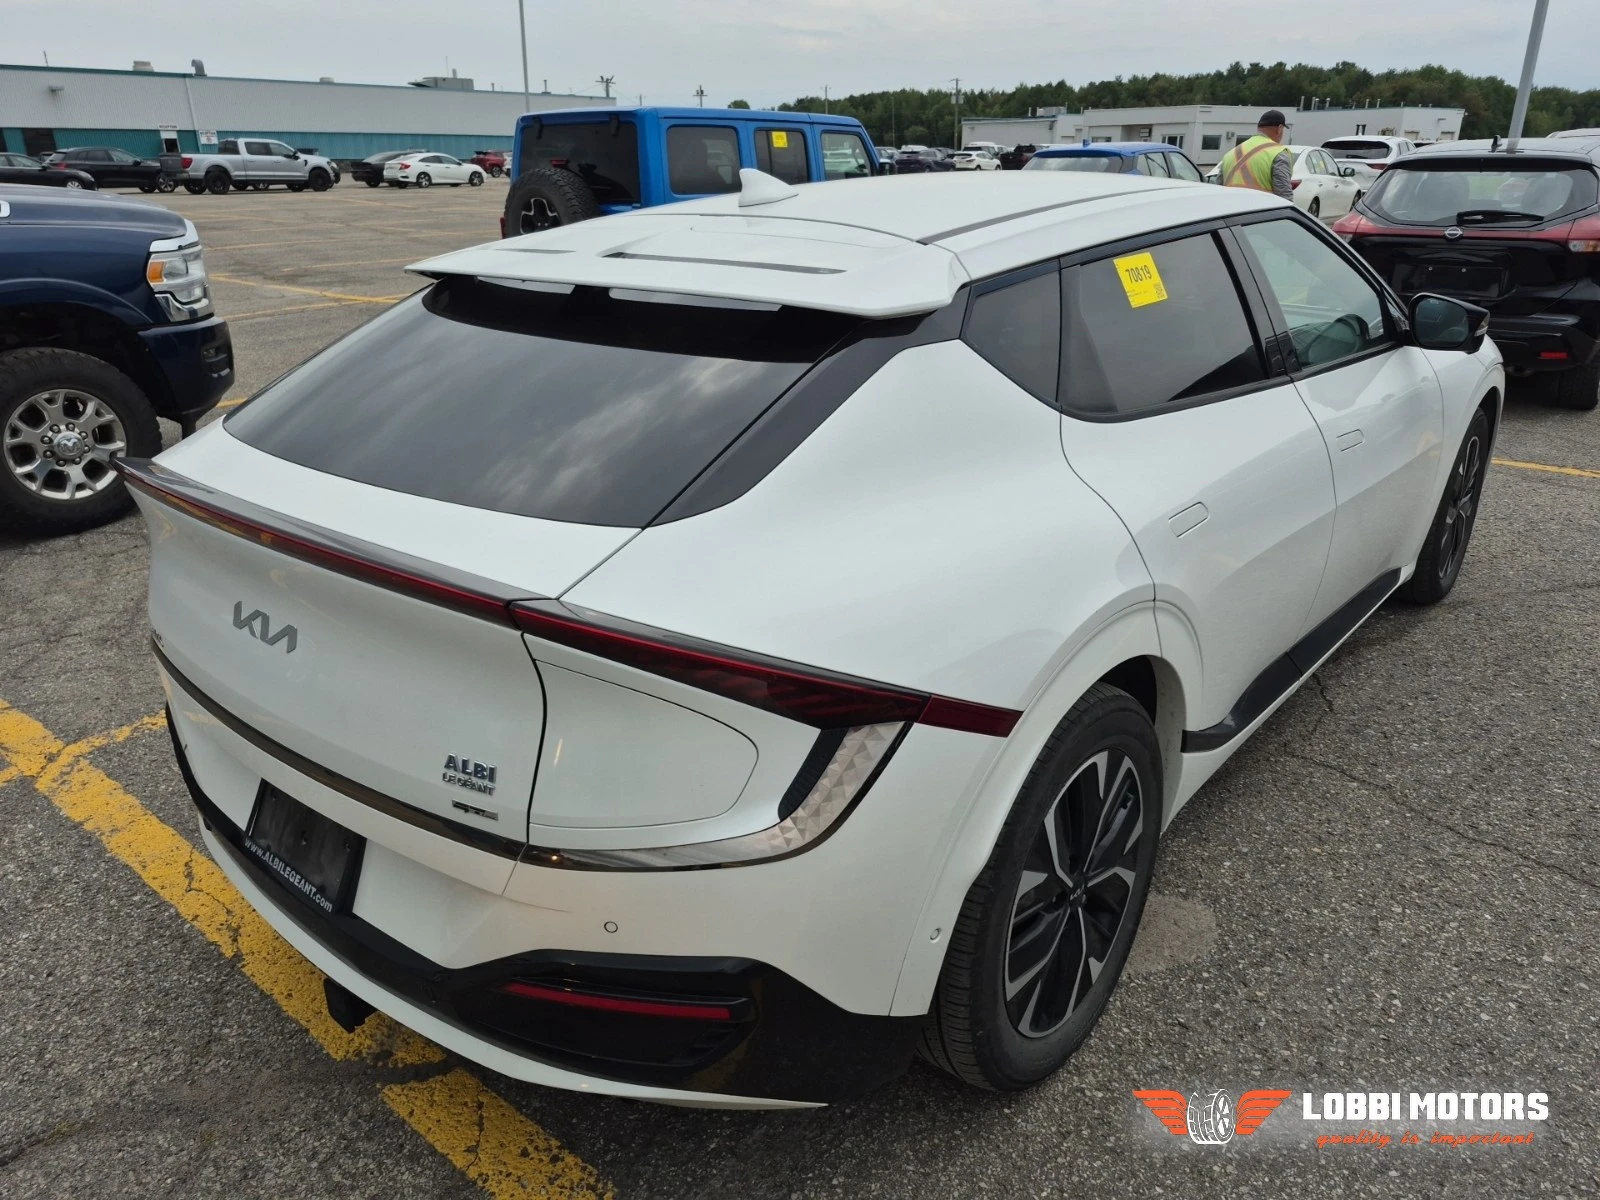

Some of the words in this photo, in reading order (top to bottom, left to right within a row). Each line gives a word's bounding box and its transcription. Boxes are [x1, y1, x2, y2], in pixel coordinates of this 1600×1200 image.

[1125, 264, 1152, 284] 70819
[233, 601, 298, 654] KIA
[442, 772, 457, 785] LE
[443, 753, 497, 783] ALBI
[244, 838, 333, 913] www.ALBILEGEANT.com
